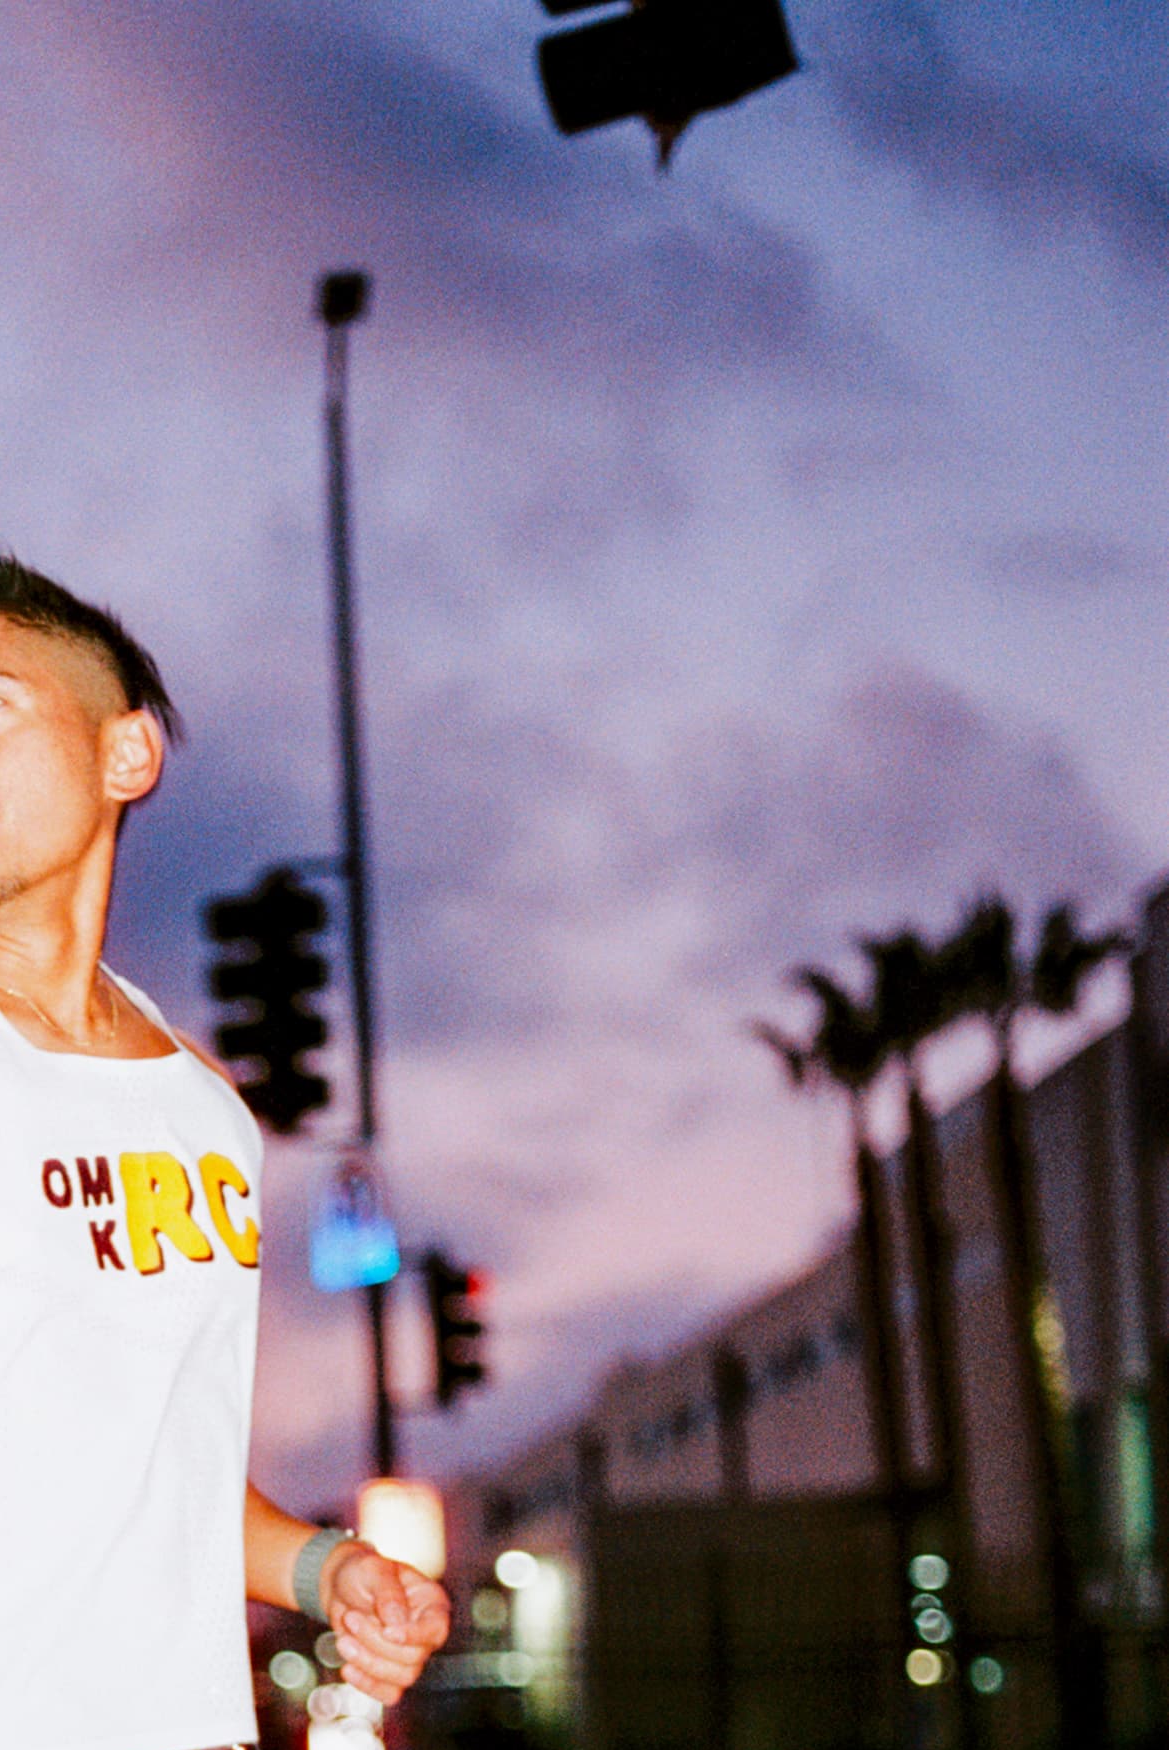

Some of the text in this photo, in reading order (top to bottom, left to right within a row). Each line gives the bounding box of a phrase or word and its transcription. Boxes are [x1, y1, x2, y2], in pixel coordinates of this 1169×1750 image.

[41, 1156, 114, 1209] OM
[118, 1151, 260, 1276] RC
[88, 1220, 126, 1271] K
